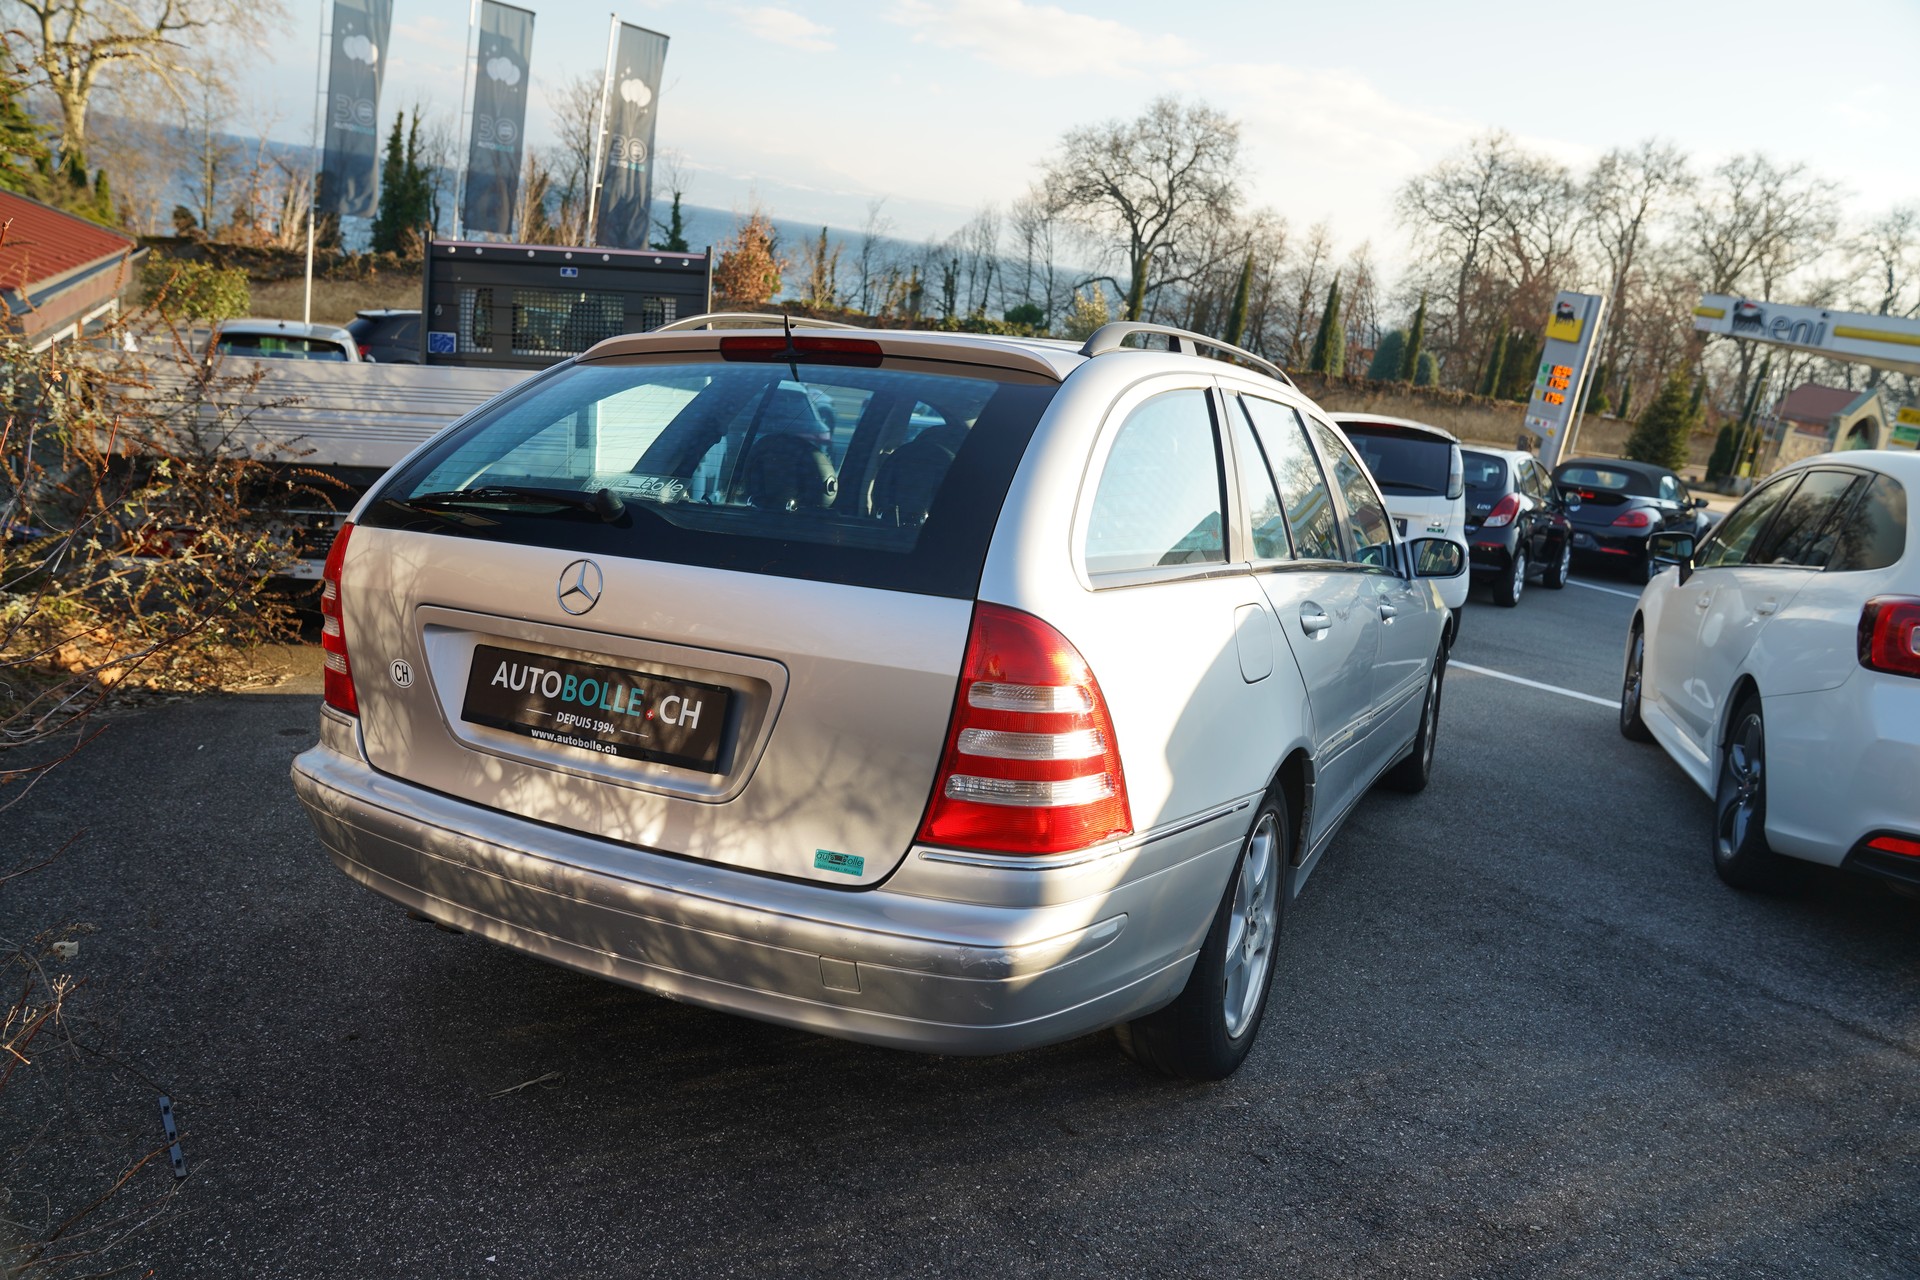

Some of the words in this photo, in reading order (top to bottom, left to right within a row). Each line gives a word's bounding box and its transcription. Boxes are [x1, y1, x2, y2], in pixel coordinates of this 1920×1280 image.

[1768, 312, 1830, 346] eni
[395, 664, 410, 683] CH
[556, 712, 591, 729] DEPUIS
[592, 720, 615, 734] 1994
[531, 728, 617, 755] www.autobolle.ch
